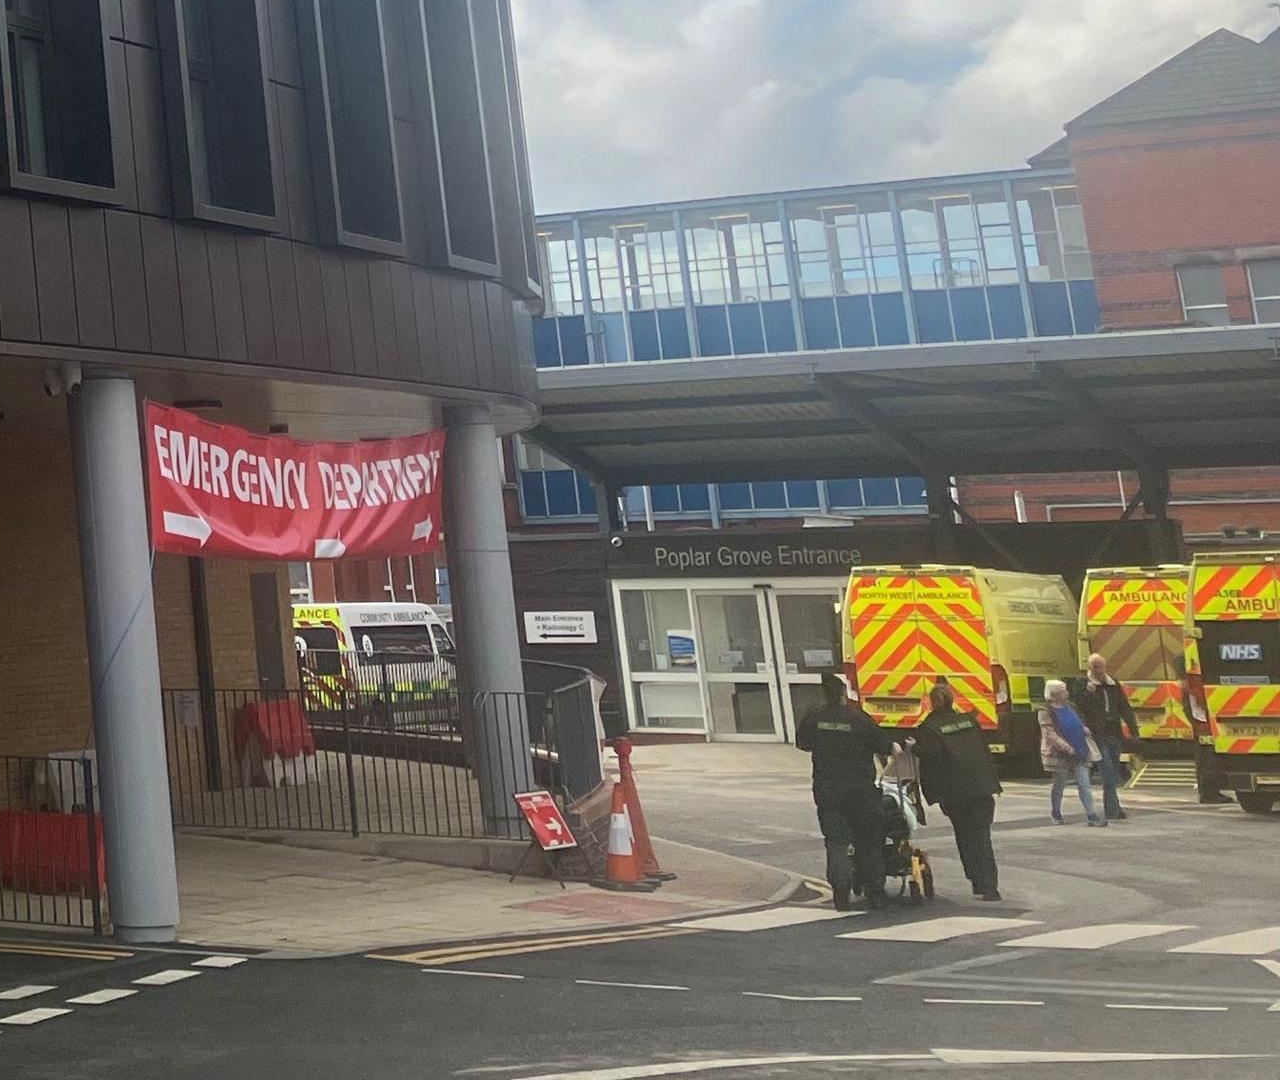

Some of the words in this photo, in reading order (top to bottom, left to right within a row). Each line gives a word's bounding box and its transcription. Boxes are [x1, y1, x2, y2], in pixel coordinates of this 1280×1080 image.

[154, 424, 310, 510] EMERGENCY
[654, 547, 711, 570] Poplar
[717, 546, 773, 566] Grove
[777, 545, 862, 565] Entrance
[860, 591, 889, 600] NORTH
[890, 591, 912, 600] WEST
[917, 591, 969, 600] AMBULANCE
[542, 624, 577, 632] Radiology
[1221, 644, 1260, 660] NHS
